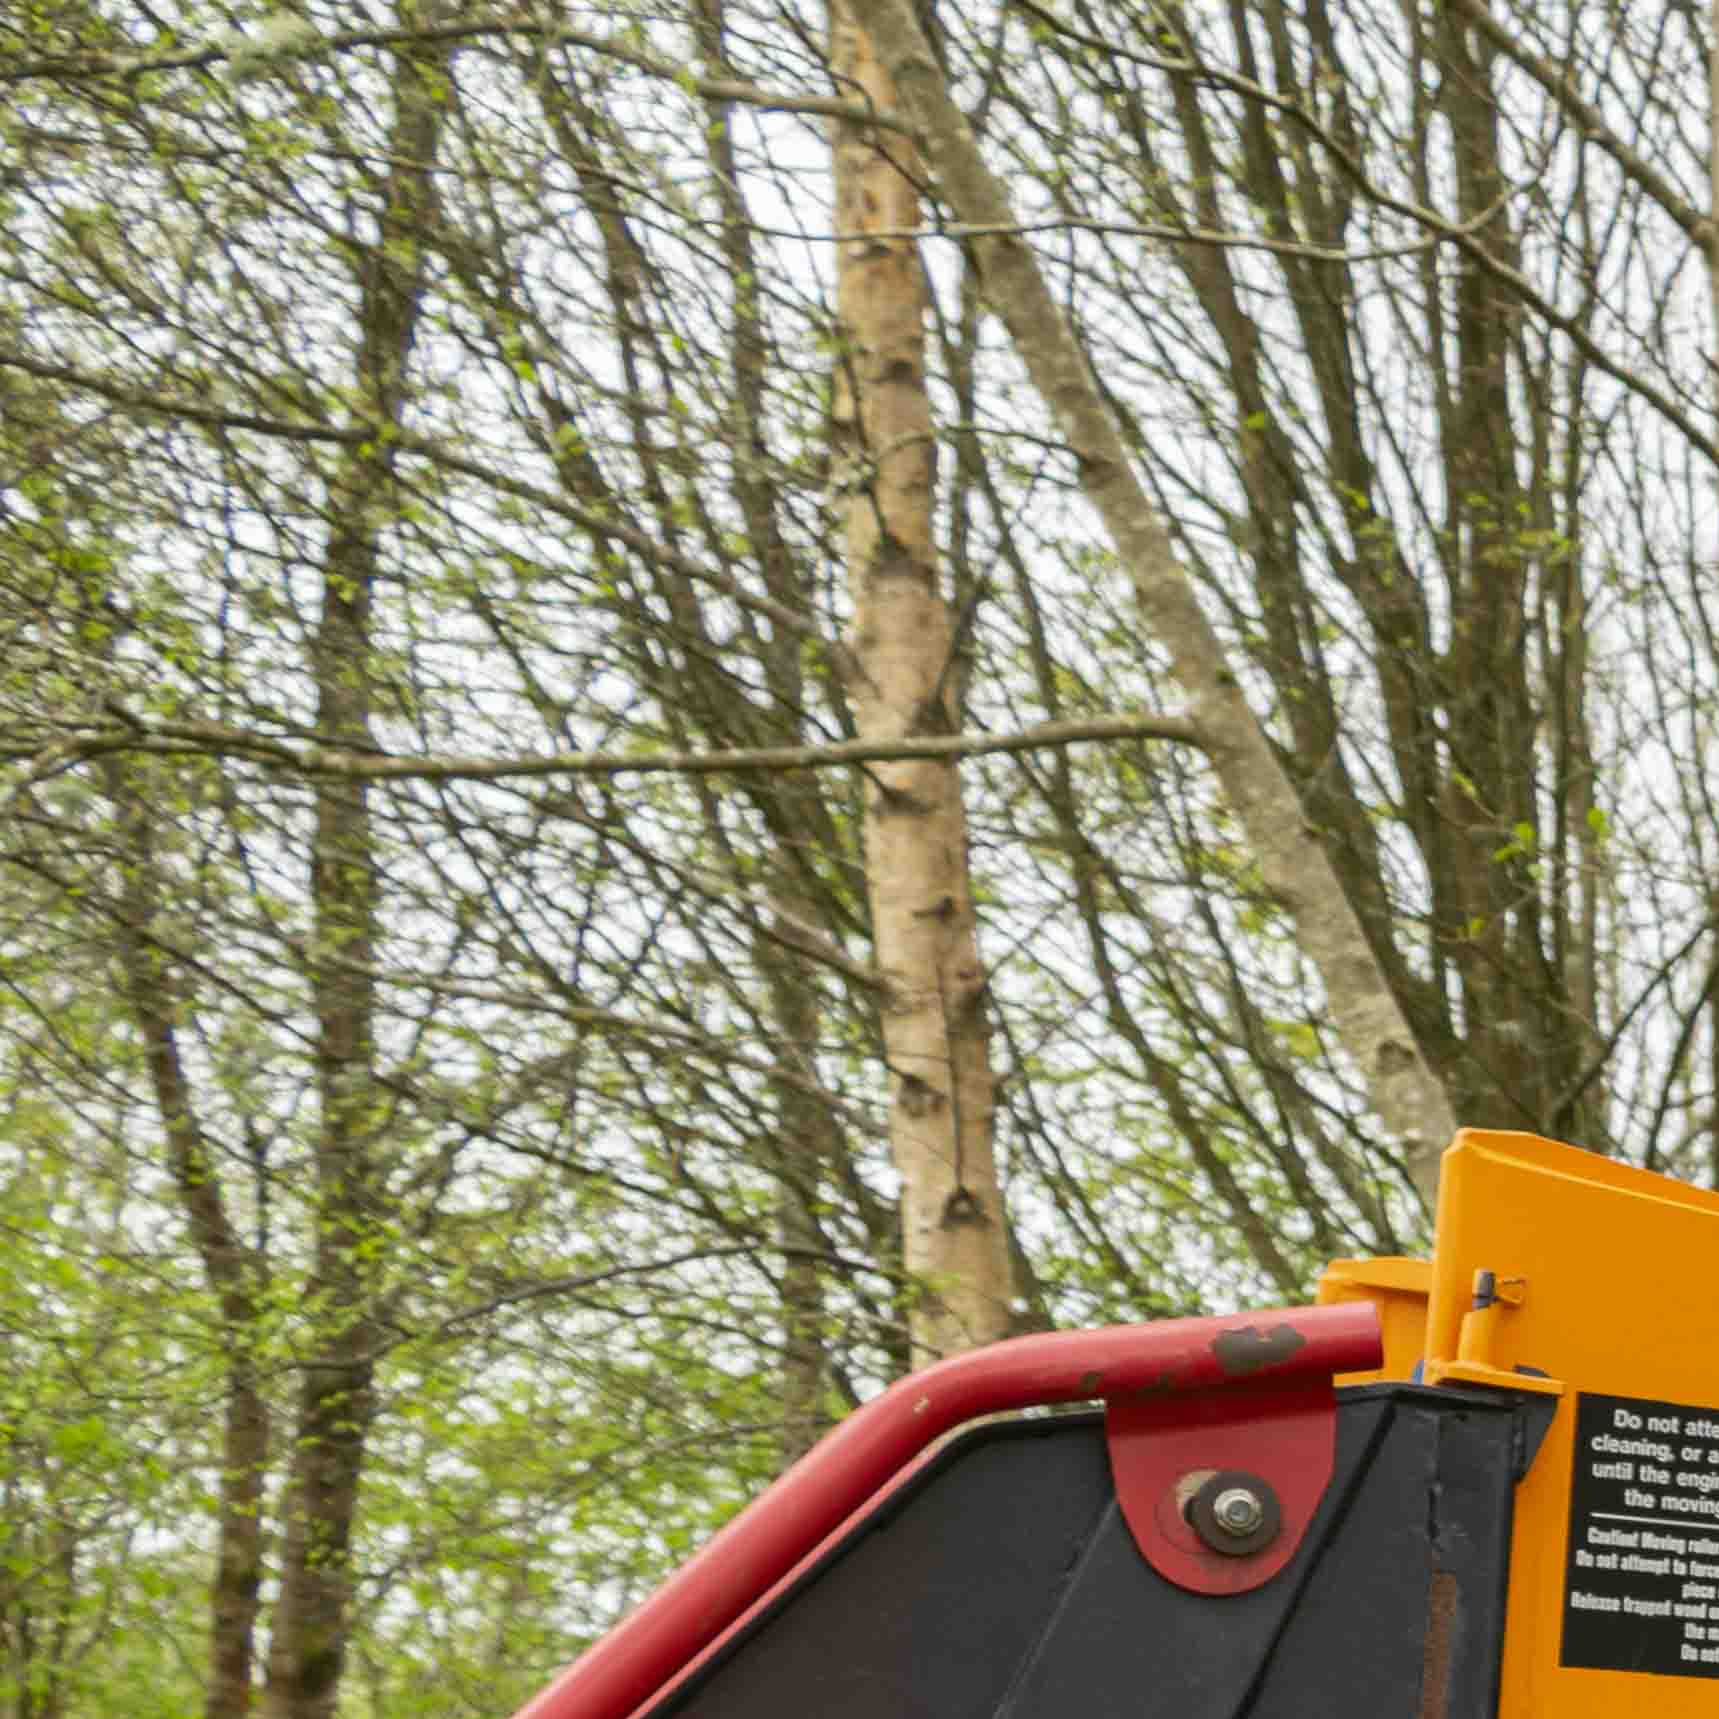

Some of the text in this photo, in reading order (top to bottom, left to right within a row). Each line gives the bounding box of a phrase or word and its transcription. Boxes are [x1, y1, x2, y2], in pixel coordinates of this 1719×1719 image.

[1613, 1409, 1642, 1430] Do
[1647, 1416, 1679, 1434] not
[1591, 1433, 1675, 1462] cleaning,
[1681, 1447, 1702, 1461] or
[1592, 1461, 1634, 1481] until
[1639, 1464, 1671, 1485] the
[1624, 1488, 1656, 1508] the
